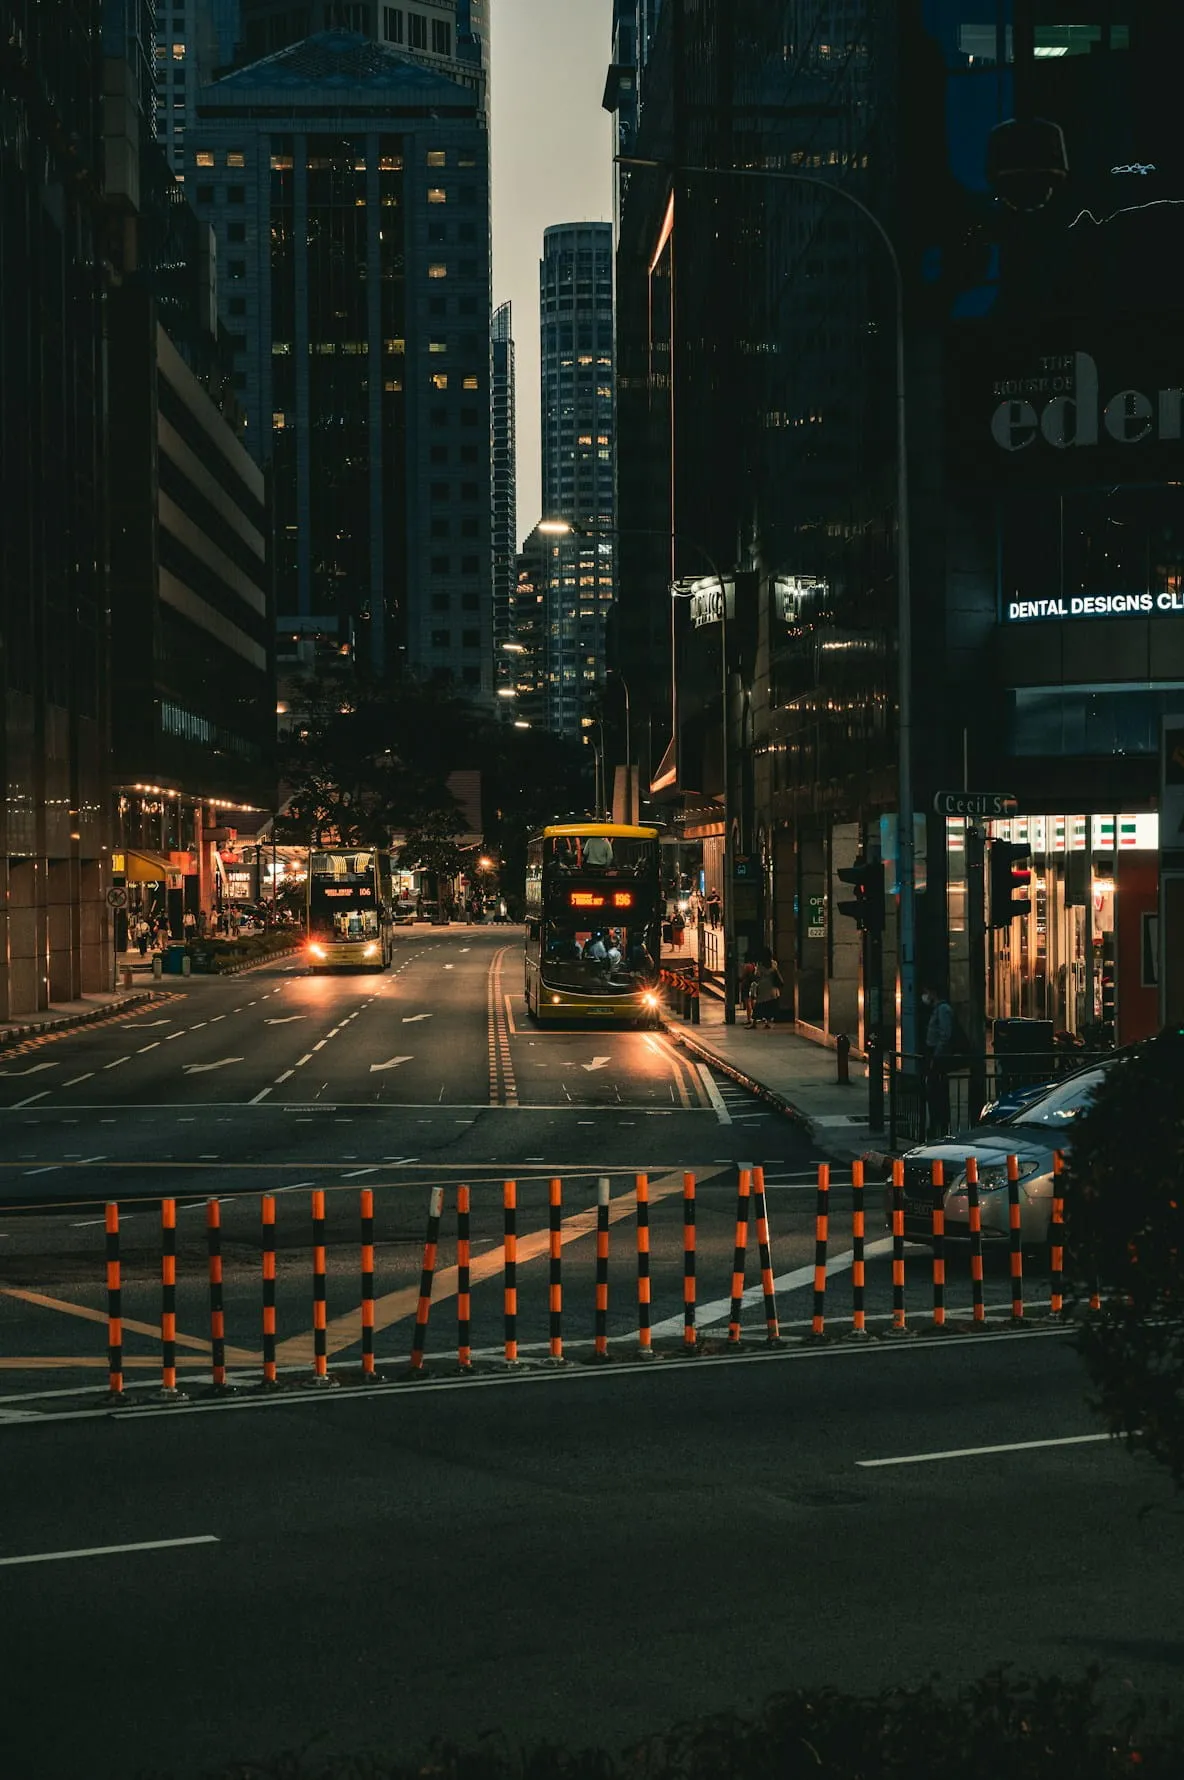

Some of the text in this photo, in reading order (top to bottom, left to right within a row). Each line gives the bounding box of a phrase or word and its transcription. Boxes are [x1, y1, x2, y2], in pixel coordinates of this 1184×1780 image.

[1039, 355, 1073, 372] THE
[1009, 593, 1184, 619] DENTAL DESIGNS CL
[945, 794, 1009, 814] Cecil St
[359, 887, 372, 897] 106
